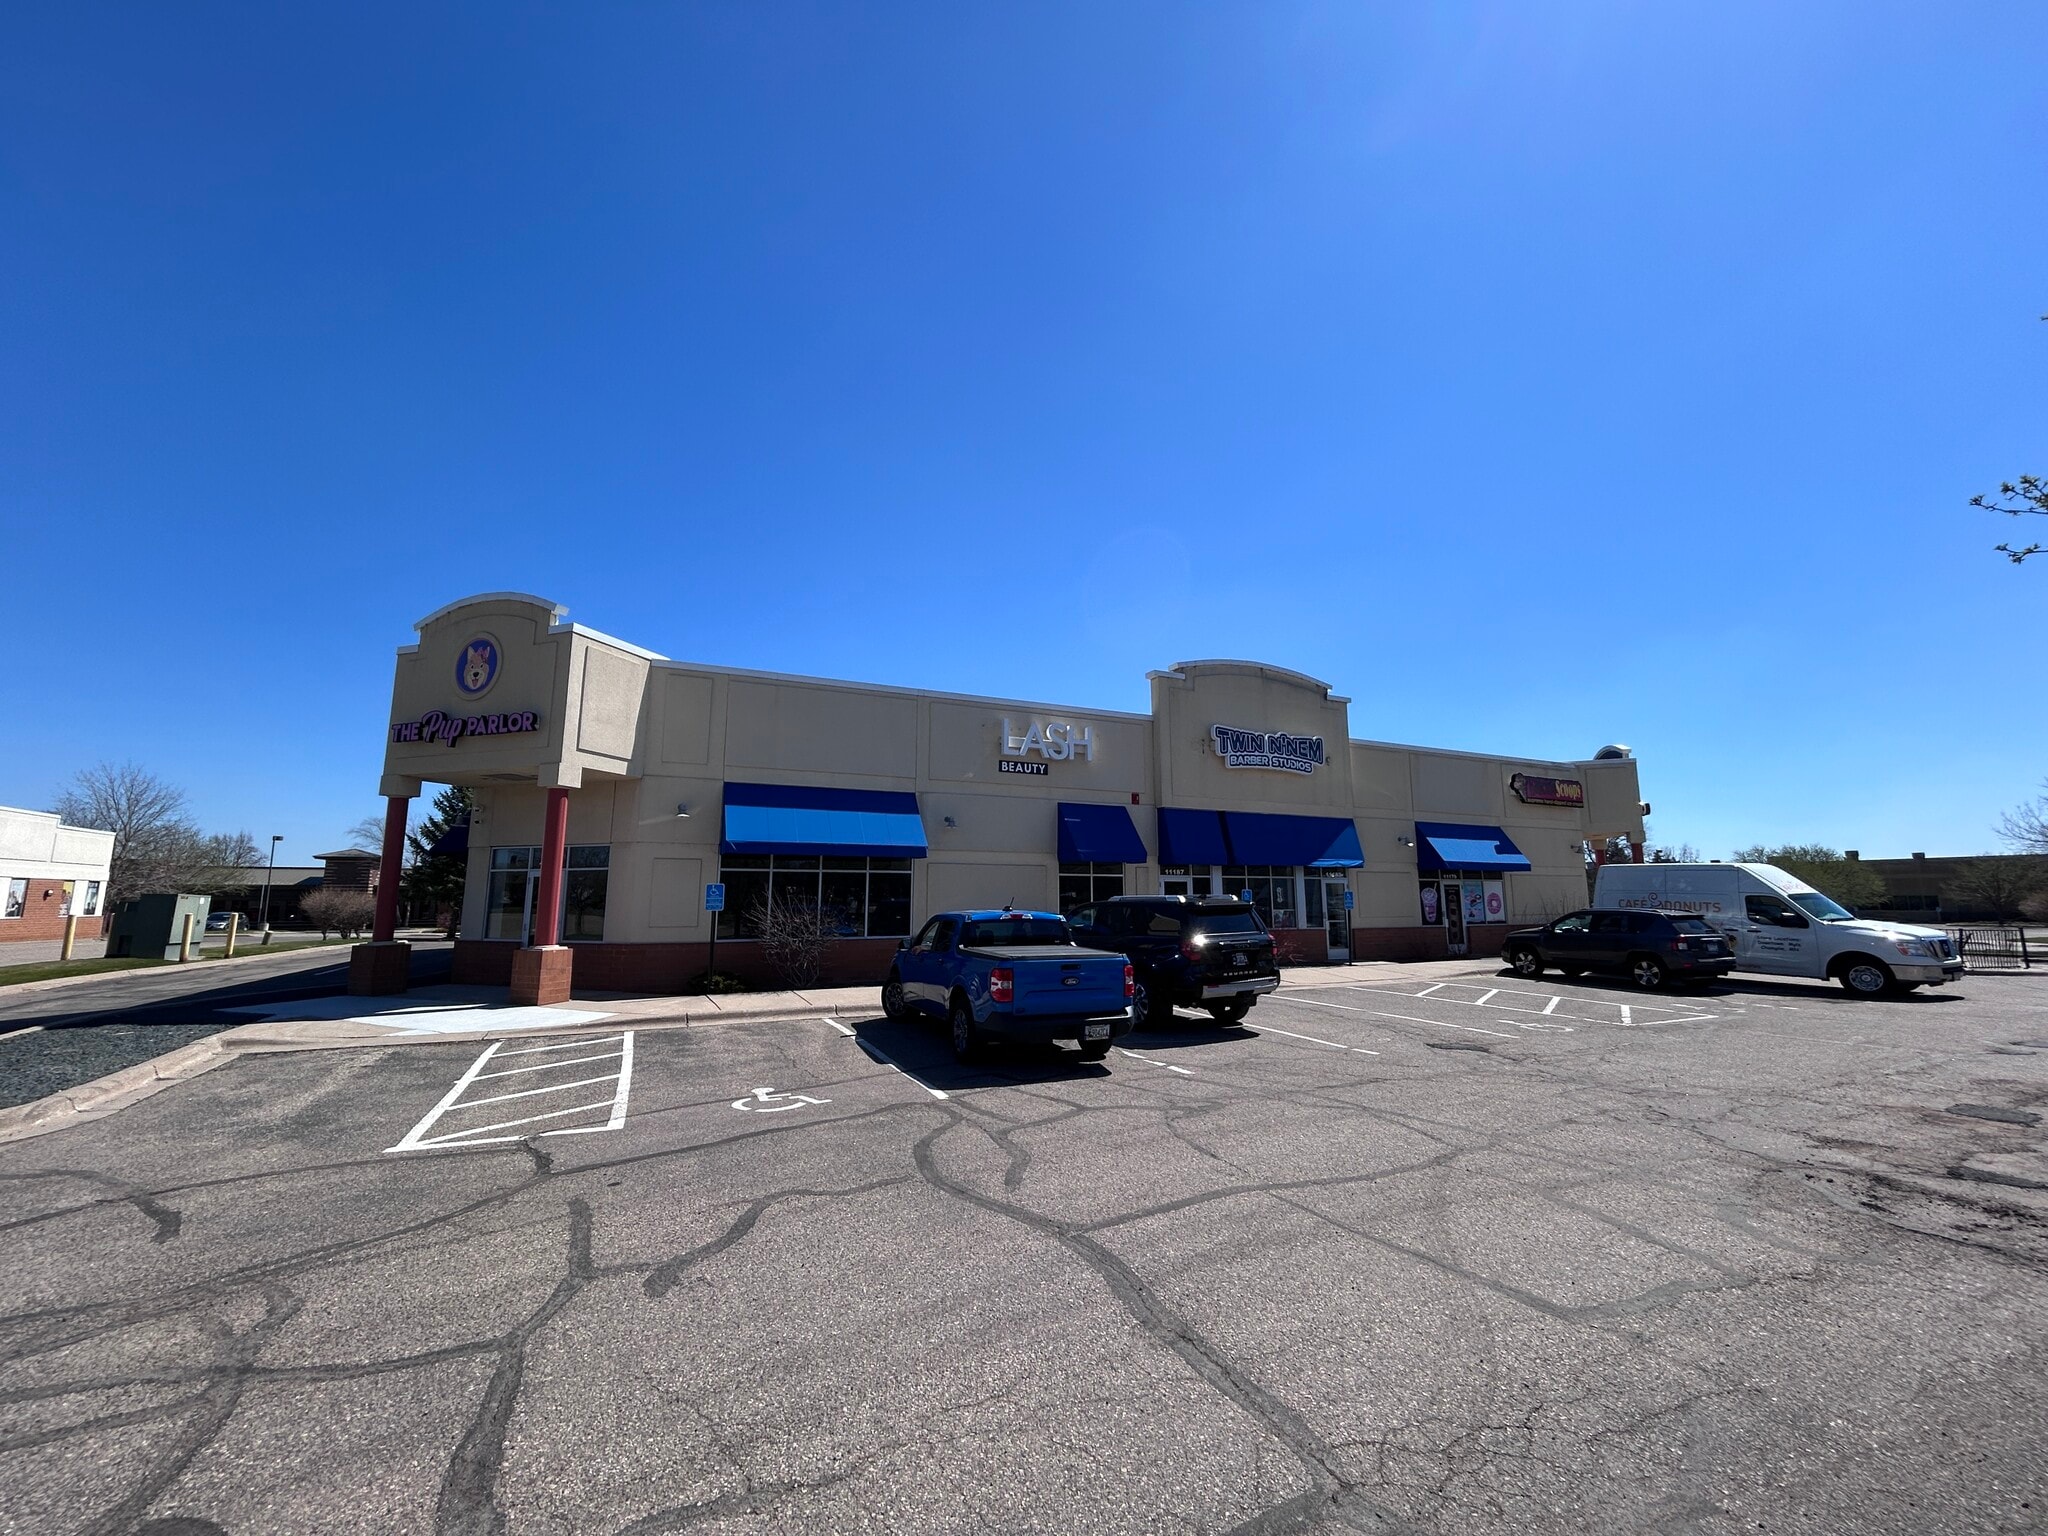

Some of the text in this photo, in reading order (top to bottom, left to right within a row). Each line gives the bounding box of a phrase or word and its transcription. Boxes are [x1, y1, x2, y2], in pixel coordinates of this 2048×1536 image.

[392, 709, 538, 748] THE Pup PARLOR
[1002, 717, 1094, 762] LASH
[1214, 726, 1265, 755] TWIN
[1001, 761, 1047, 774] BEAUTY
[1229, 755, 1313, 773] BARBER STUDIOS
[1662, 901, 1722, 913] DONUTS
